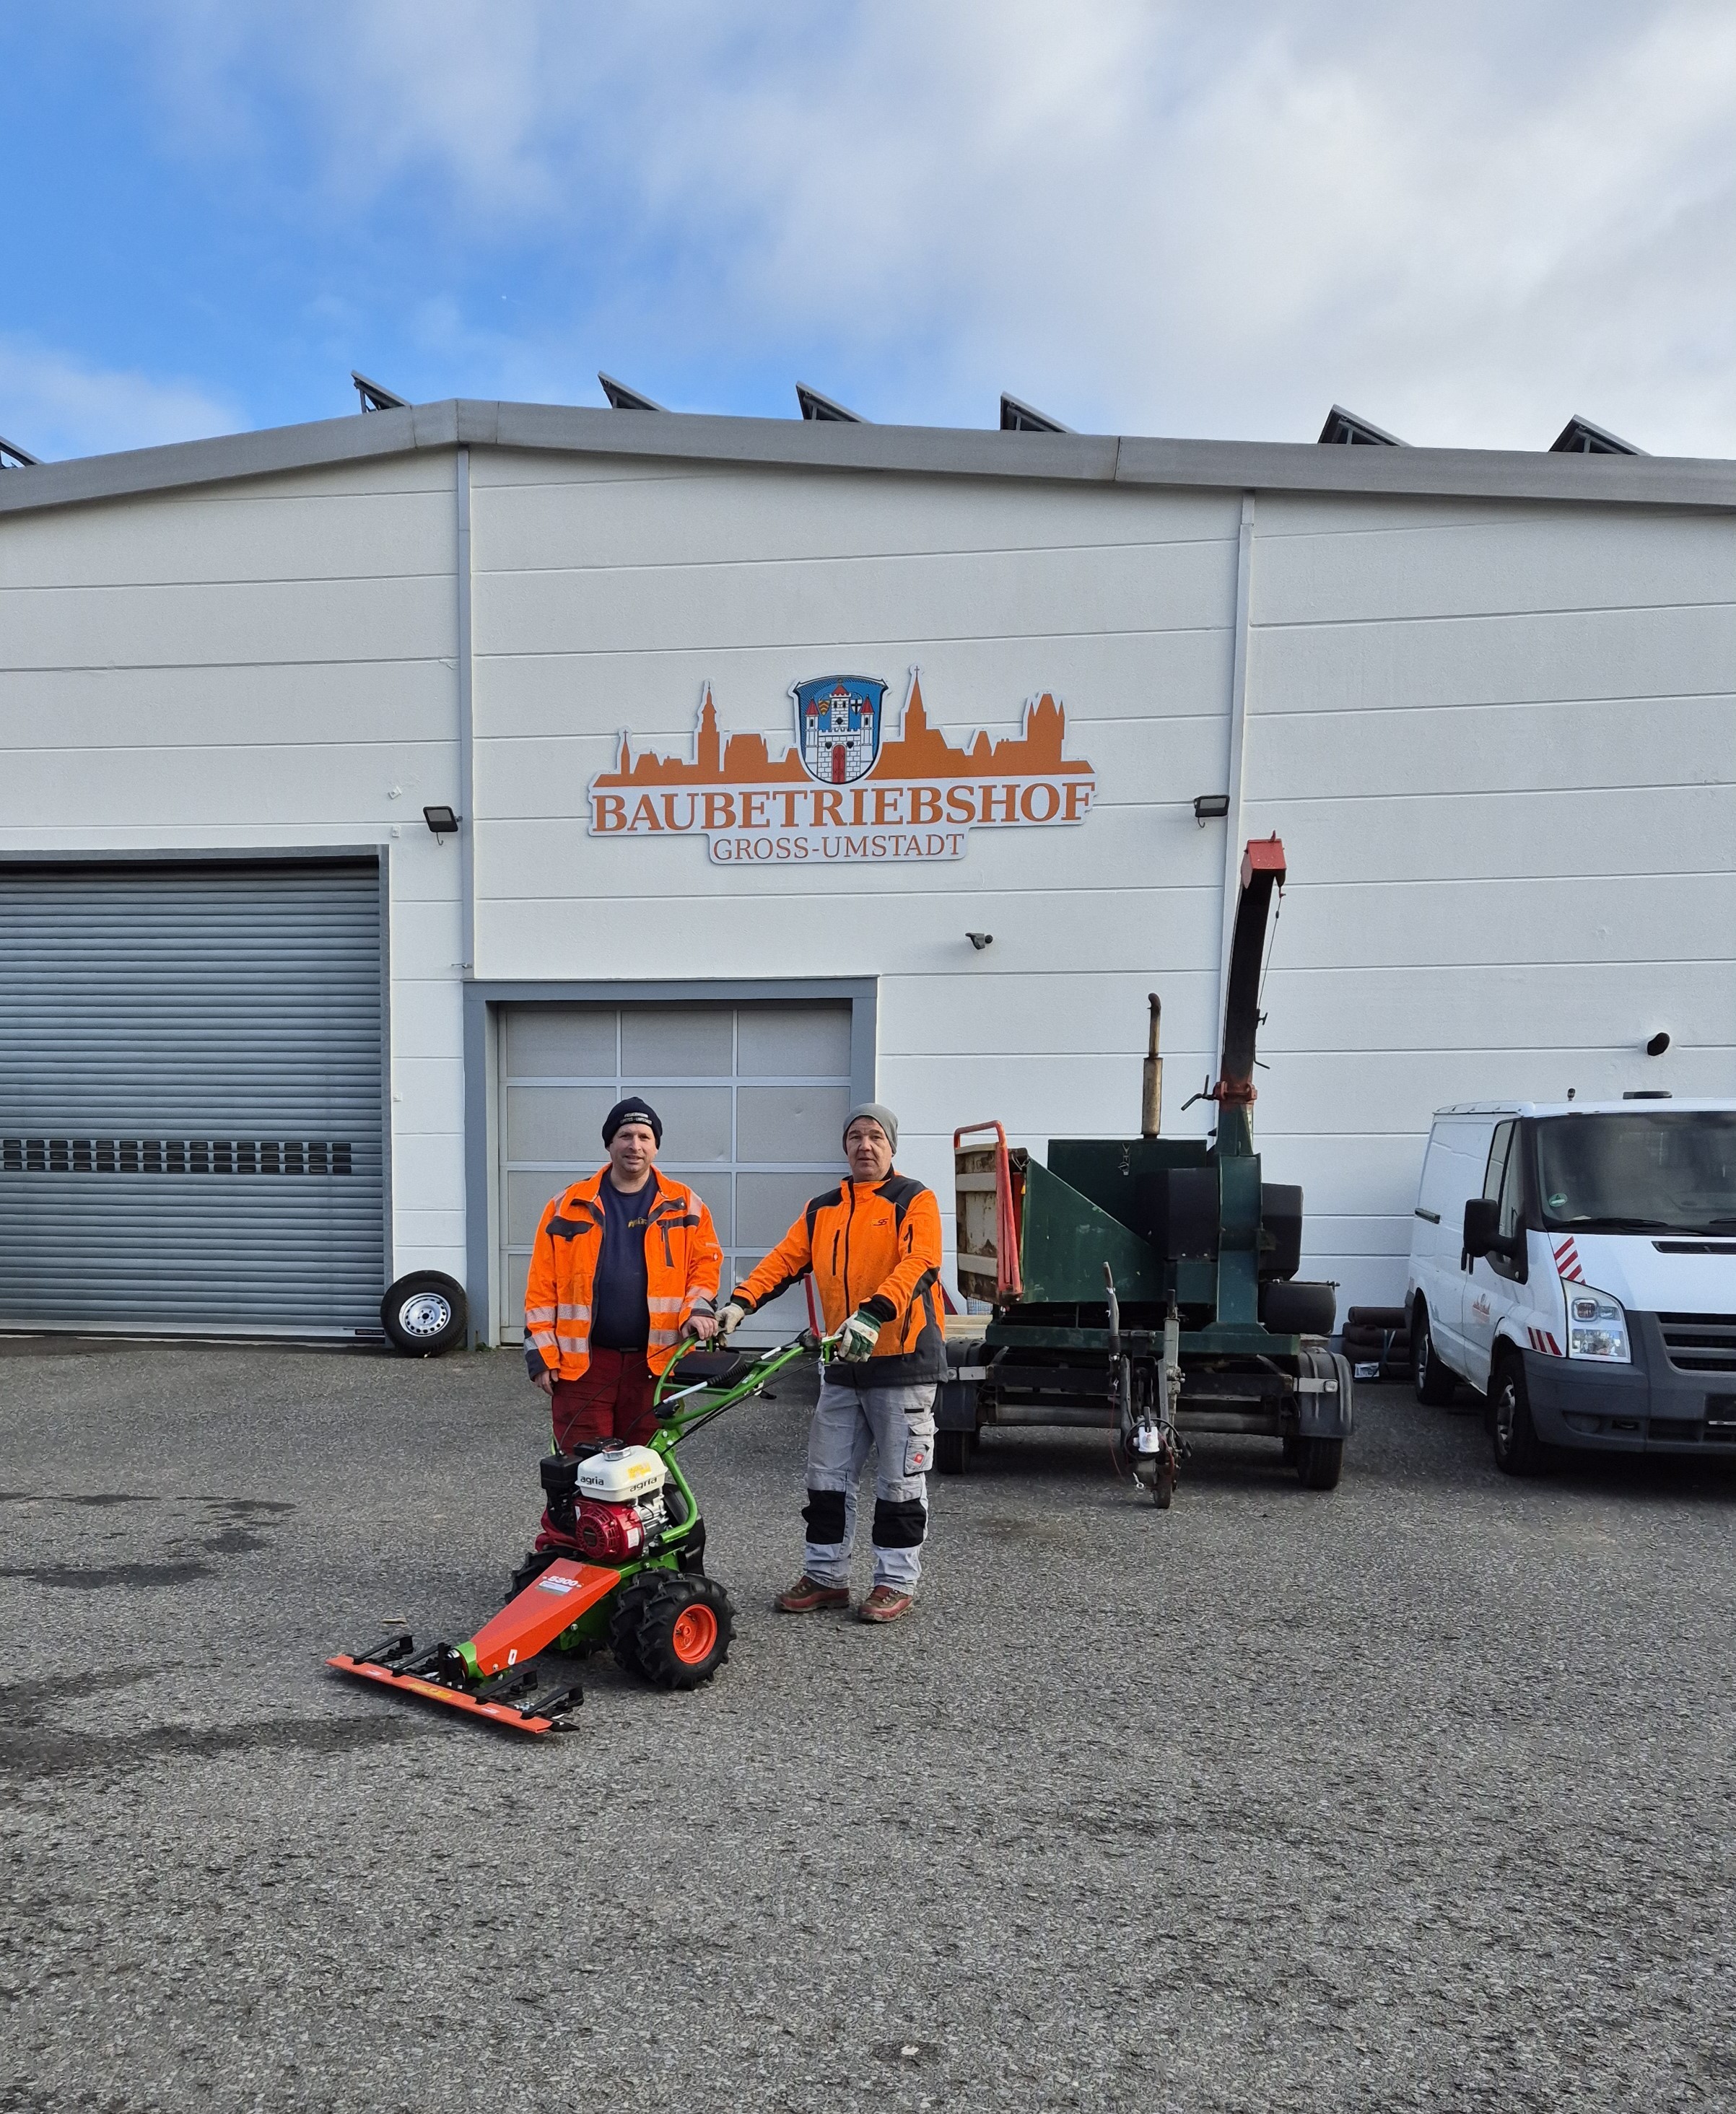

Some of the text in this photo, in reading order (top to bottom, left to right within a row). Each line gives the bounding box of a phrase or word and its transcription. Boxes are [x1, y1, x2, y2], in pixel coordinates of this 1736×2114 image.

[592, 782, 1096, 831] BAUBETRIEBSHOF
[713, 834, 964, 860] GROSS-UMSTADT
[580, 1476, 604, 1485] agria
[629, 1477, 658, 1492] agria
